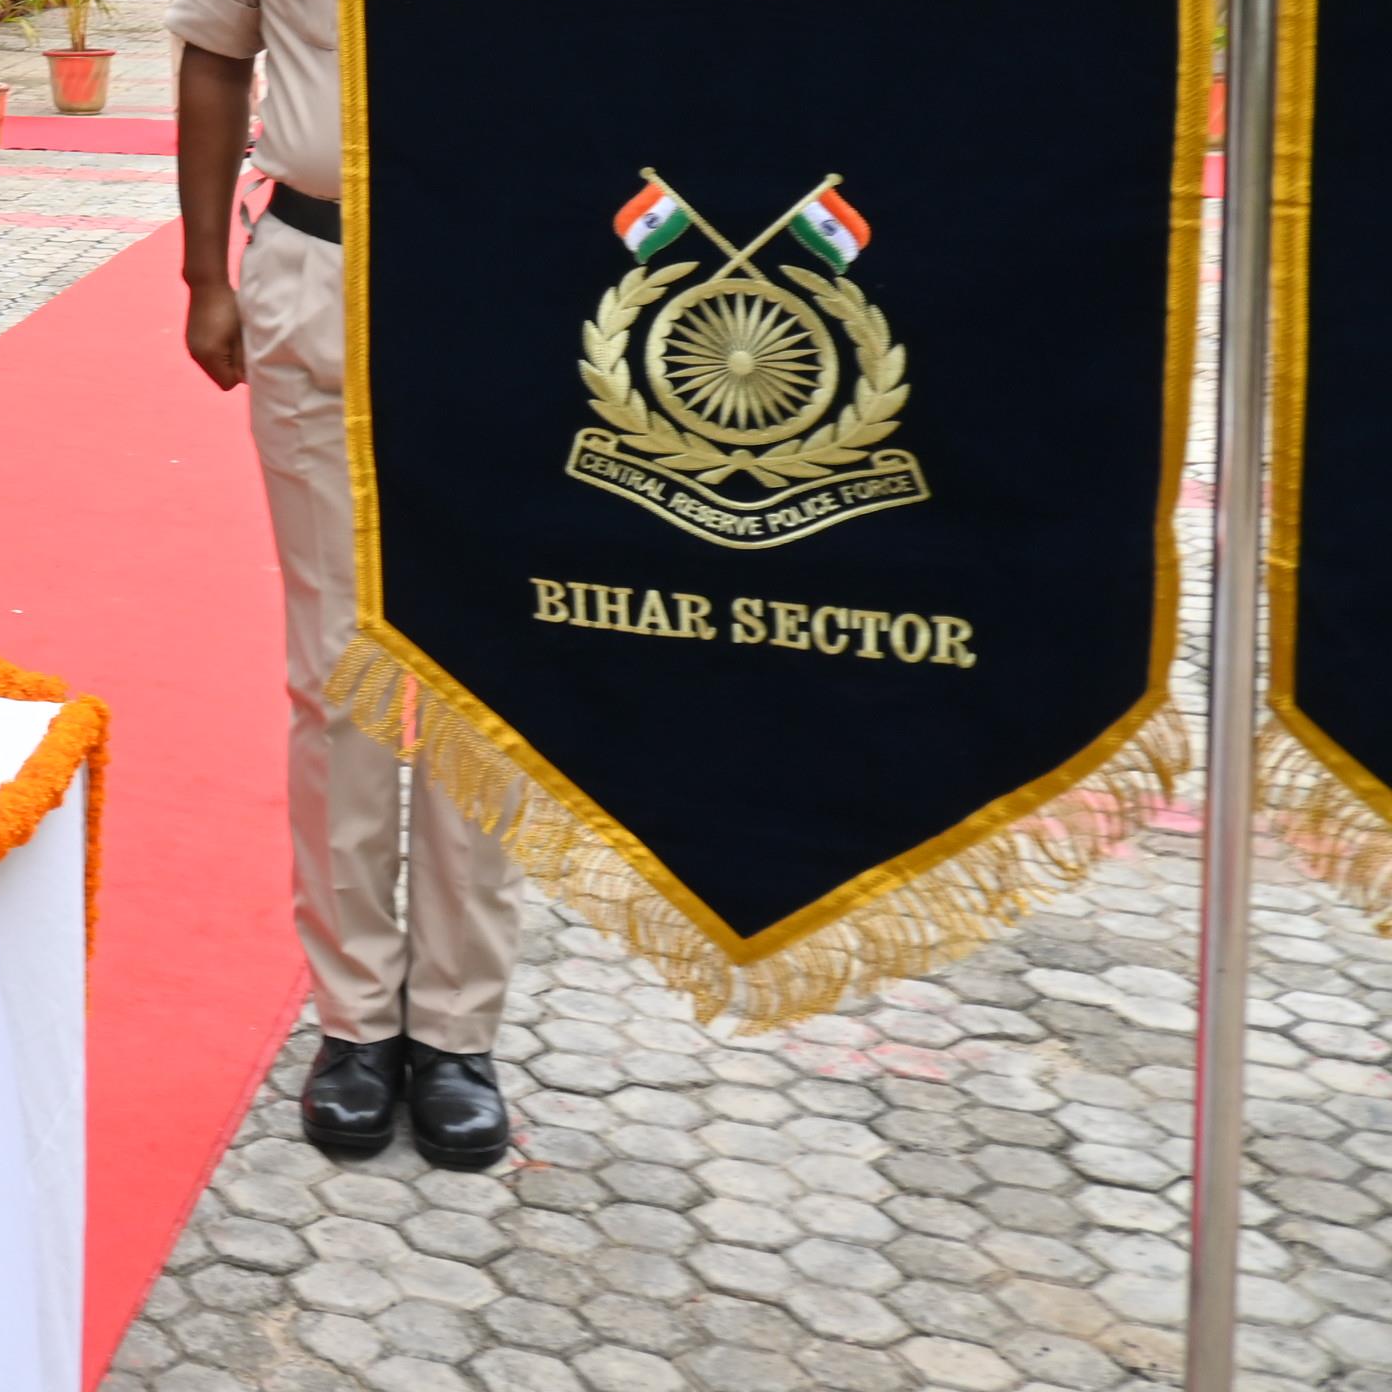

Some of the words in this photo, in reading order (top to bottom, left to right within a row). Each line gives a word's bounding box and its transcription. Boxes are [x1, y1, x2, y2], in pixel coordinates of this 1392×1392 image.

[579, 453, 666, 501] CENTRAL
[667, 491, 765, 536] RESERVE
[765, 491, 842, 533] POLICE
[837, 474, 916, 505] FORCE
[529, 577, 717, 640] BIHAR
[730, 596, 978, 668] SECTOR
